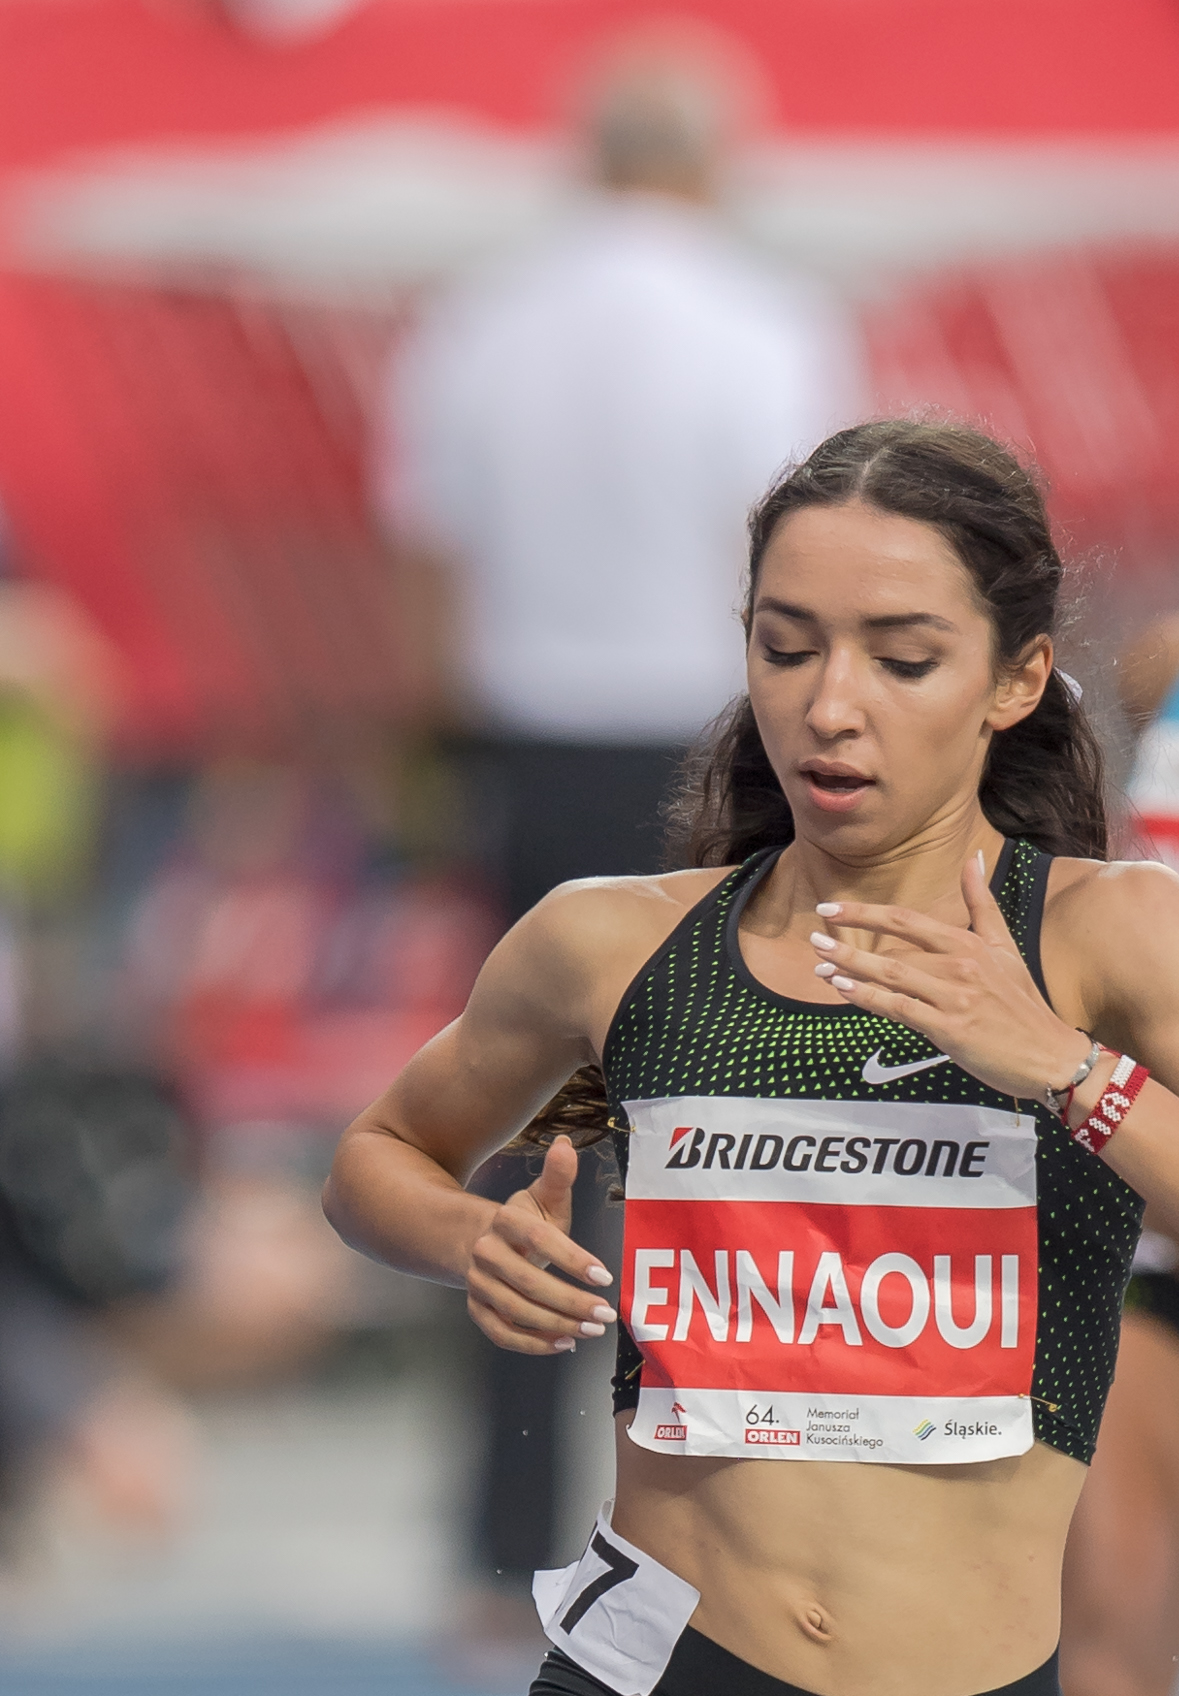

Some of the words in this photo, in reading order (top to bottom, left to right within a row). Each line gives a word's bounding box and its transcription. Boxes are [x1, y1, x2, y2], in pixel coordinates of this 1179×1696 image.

[665, 1127, 990, 1178] BRIDGESTONE
[630, 1248, 1019, 1350] ENNAOUI
[745, 1404, 780, 1426] 64.
[806, 1407, 859, 1420] Memoriał
[806, 1421, 850, 1432] Janusza
[944, 1419, 1002, 1439] Śląskie.
[747, 1430, 798, 1444] ORLEN
[806, 1433, 883, 1449] Kusocińskiego
[559, 1530, 640, 1635] 7
